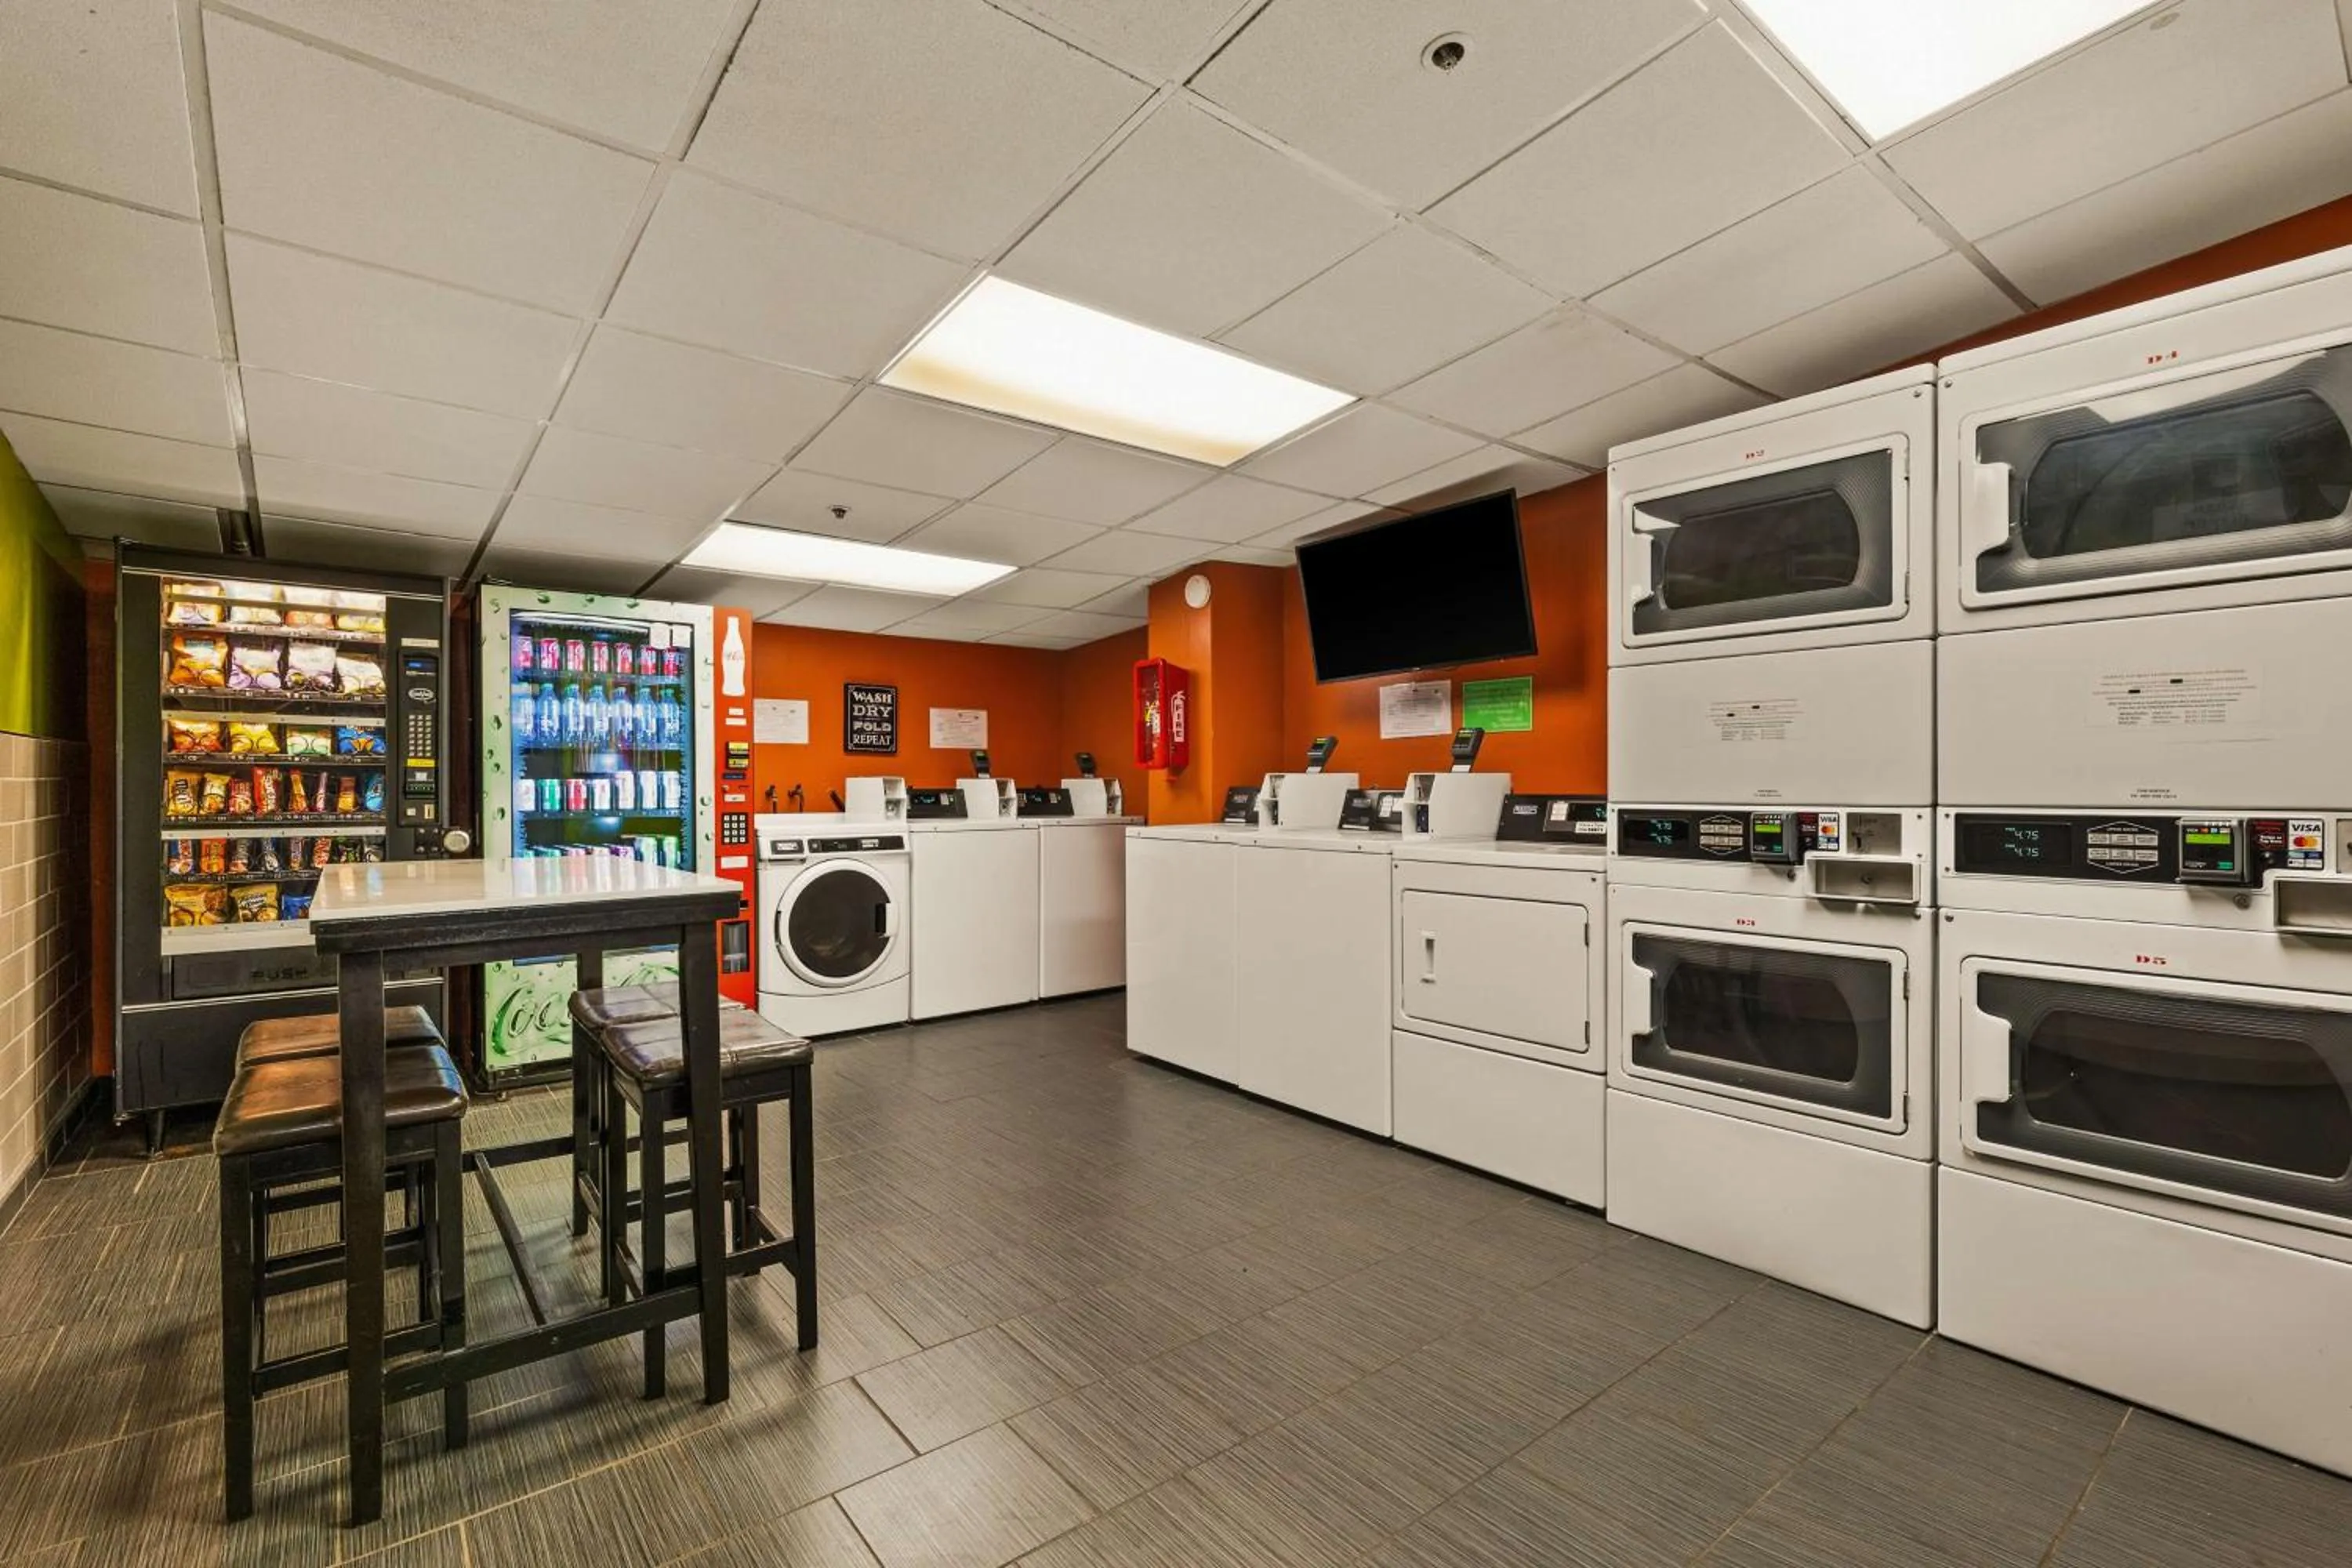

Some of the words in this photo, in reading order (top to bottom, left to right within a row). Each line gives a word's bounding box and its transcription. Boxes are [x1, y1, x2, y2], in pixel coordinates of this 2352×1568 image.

[853, 691, 892, 704] WASH
[853, 704, 892, 717] DRY
[853, 721, 891, 731] FOLD
[853, 734, 891, 746] REPEAT
